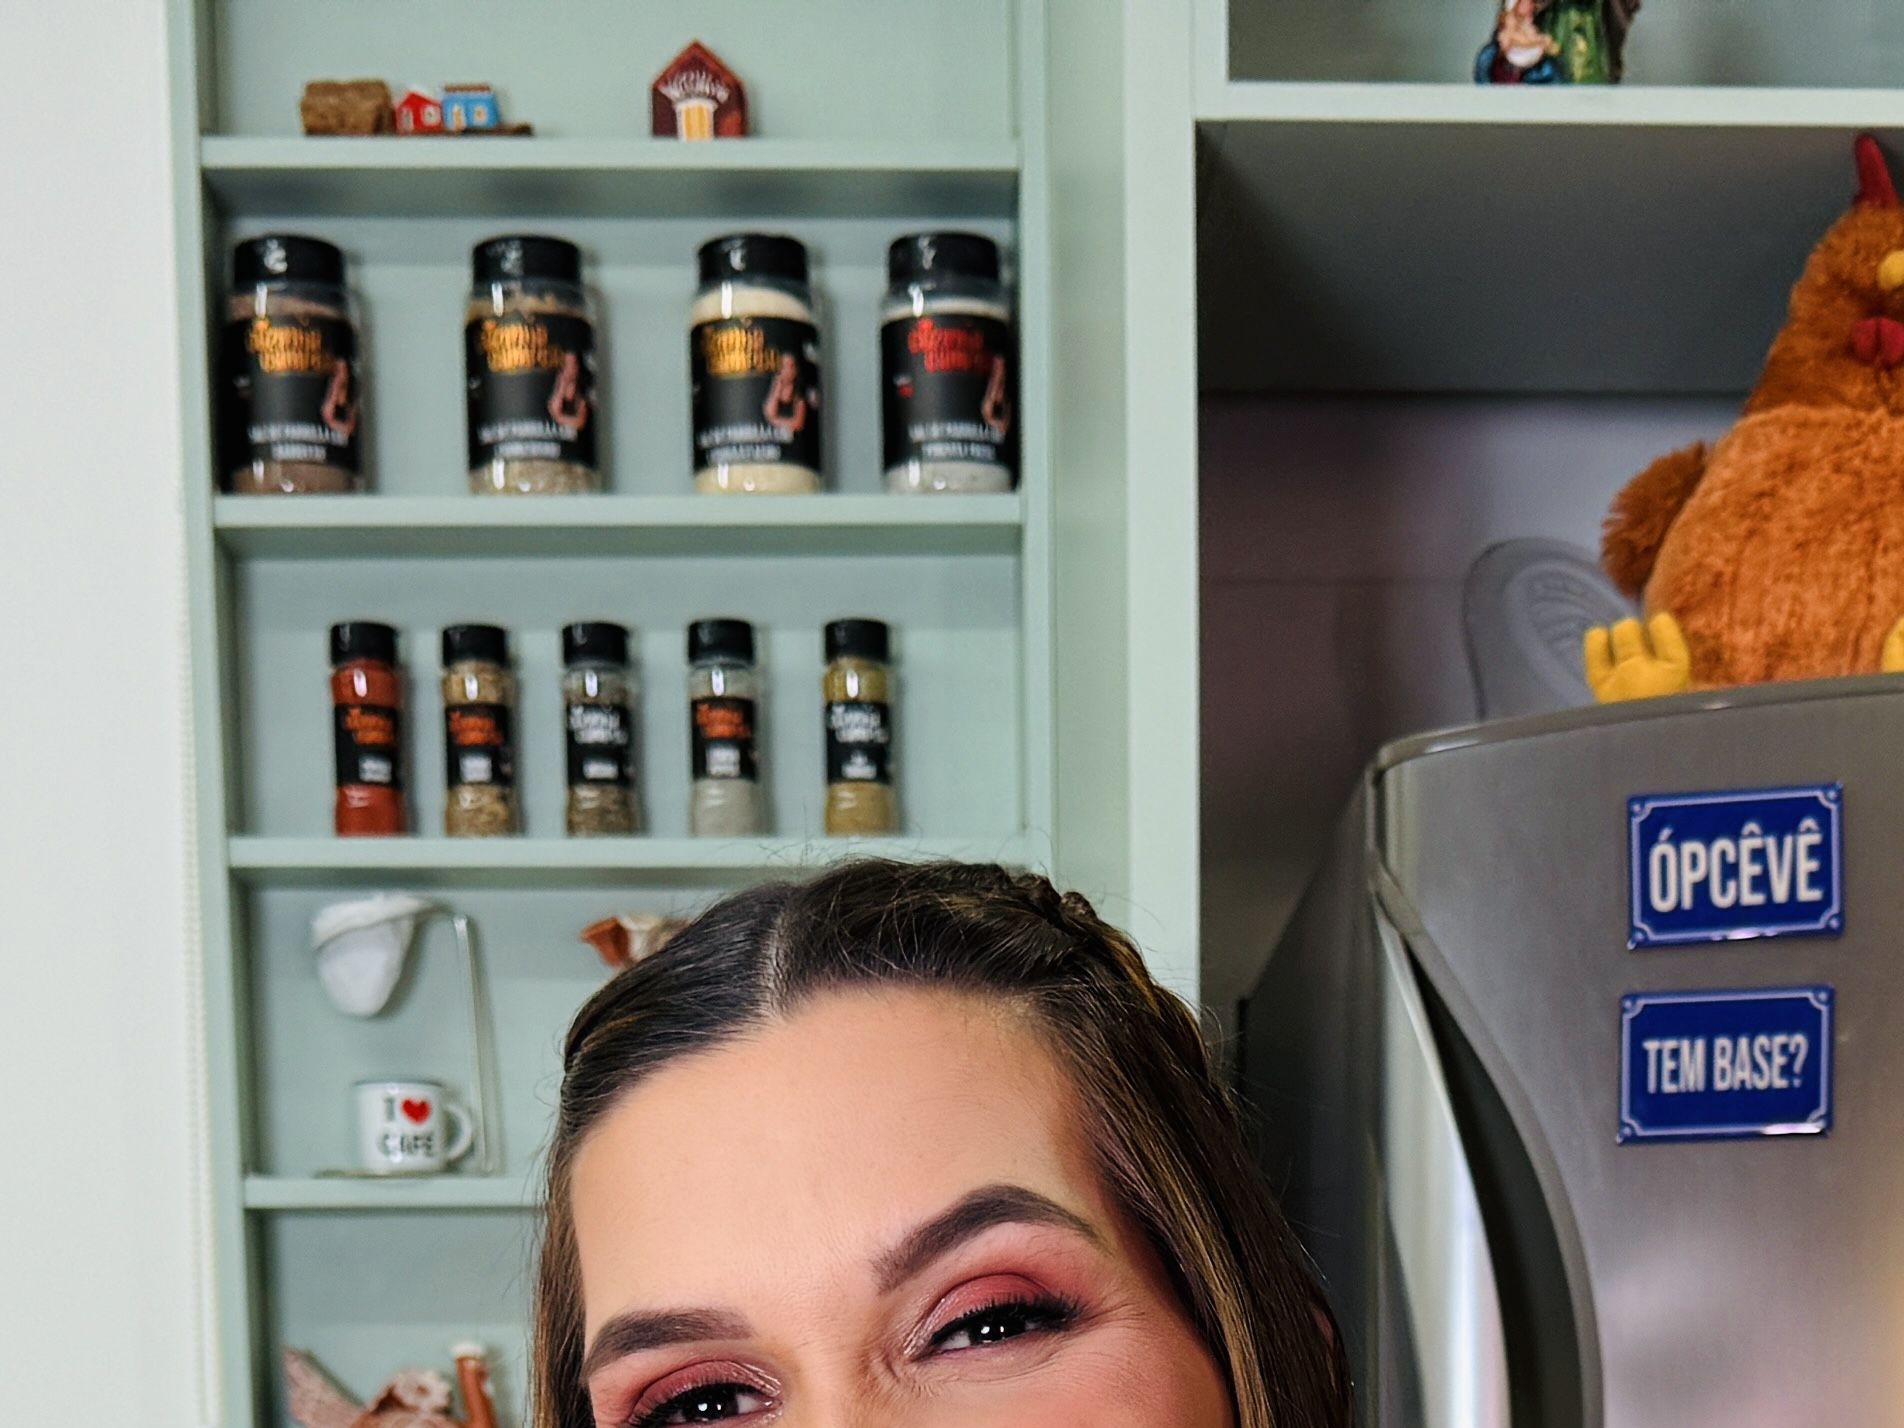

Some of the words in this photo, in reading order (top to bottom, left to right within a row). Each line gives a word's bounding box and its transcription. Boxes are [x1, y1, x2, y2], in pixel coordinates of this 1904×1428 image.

[1649, 817, 1823, 912] ÓPCÊVÊ
[1643, 1036, 1706, 1094] TEM
[1713, 1033, 1808, 1091] BASE?
